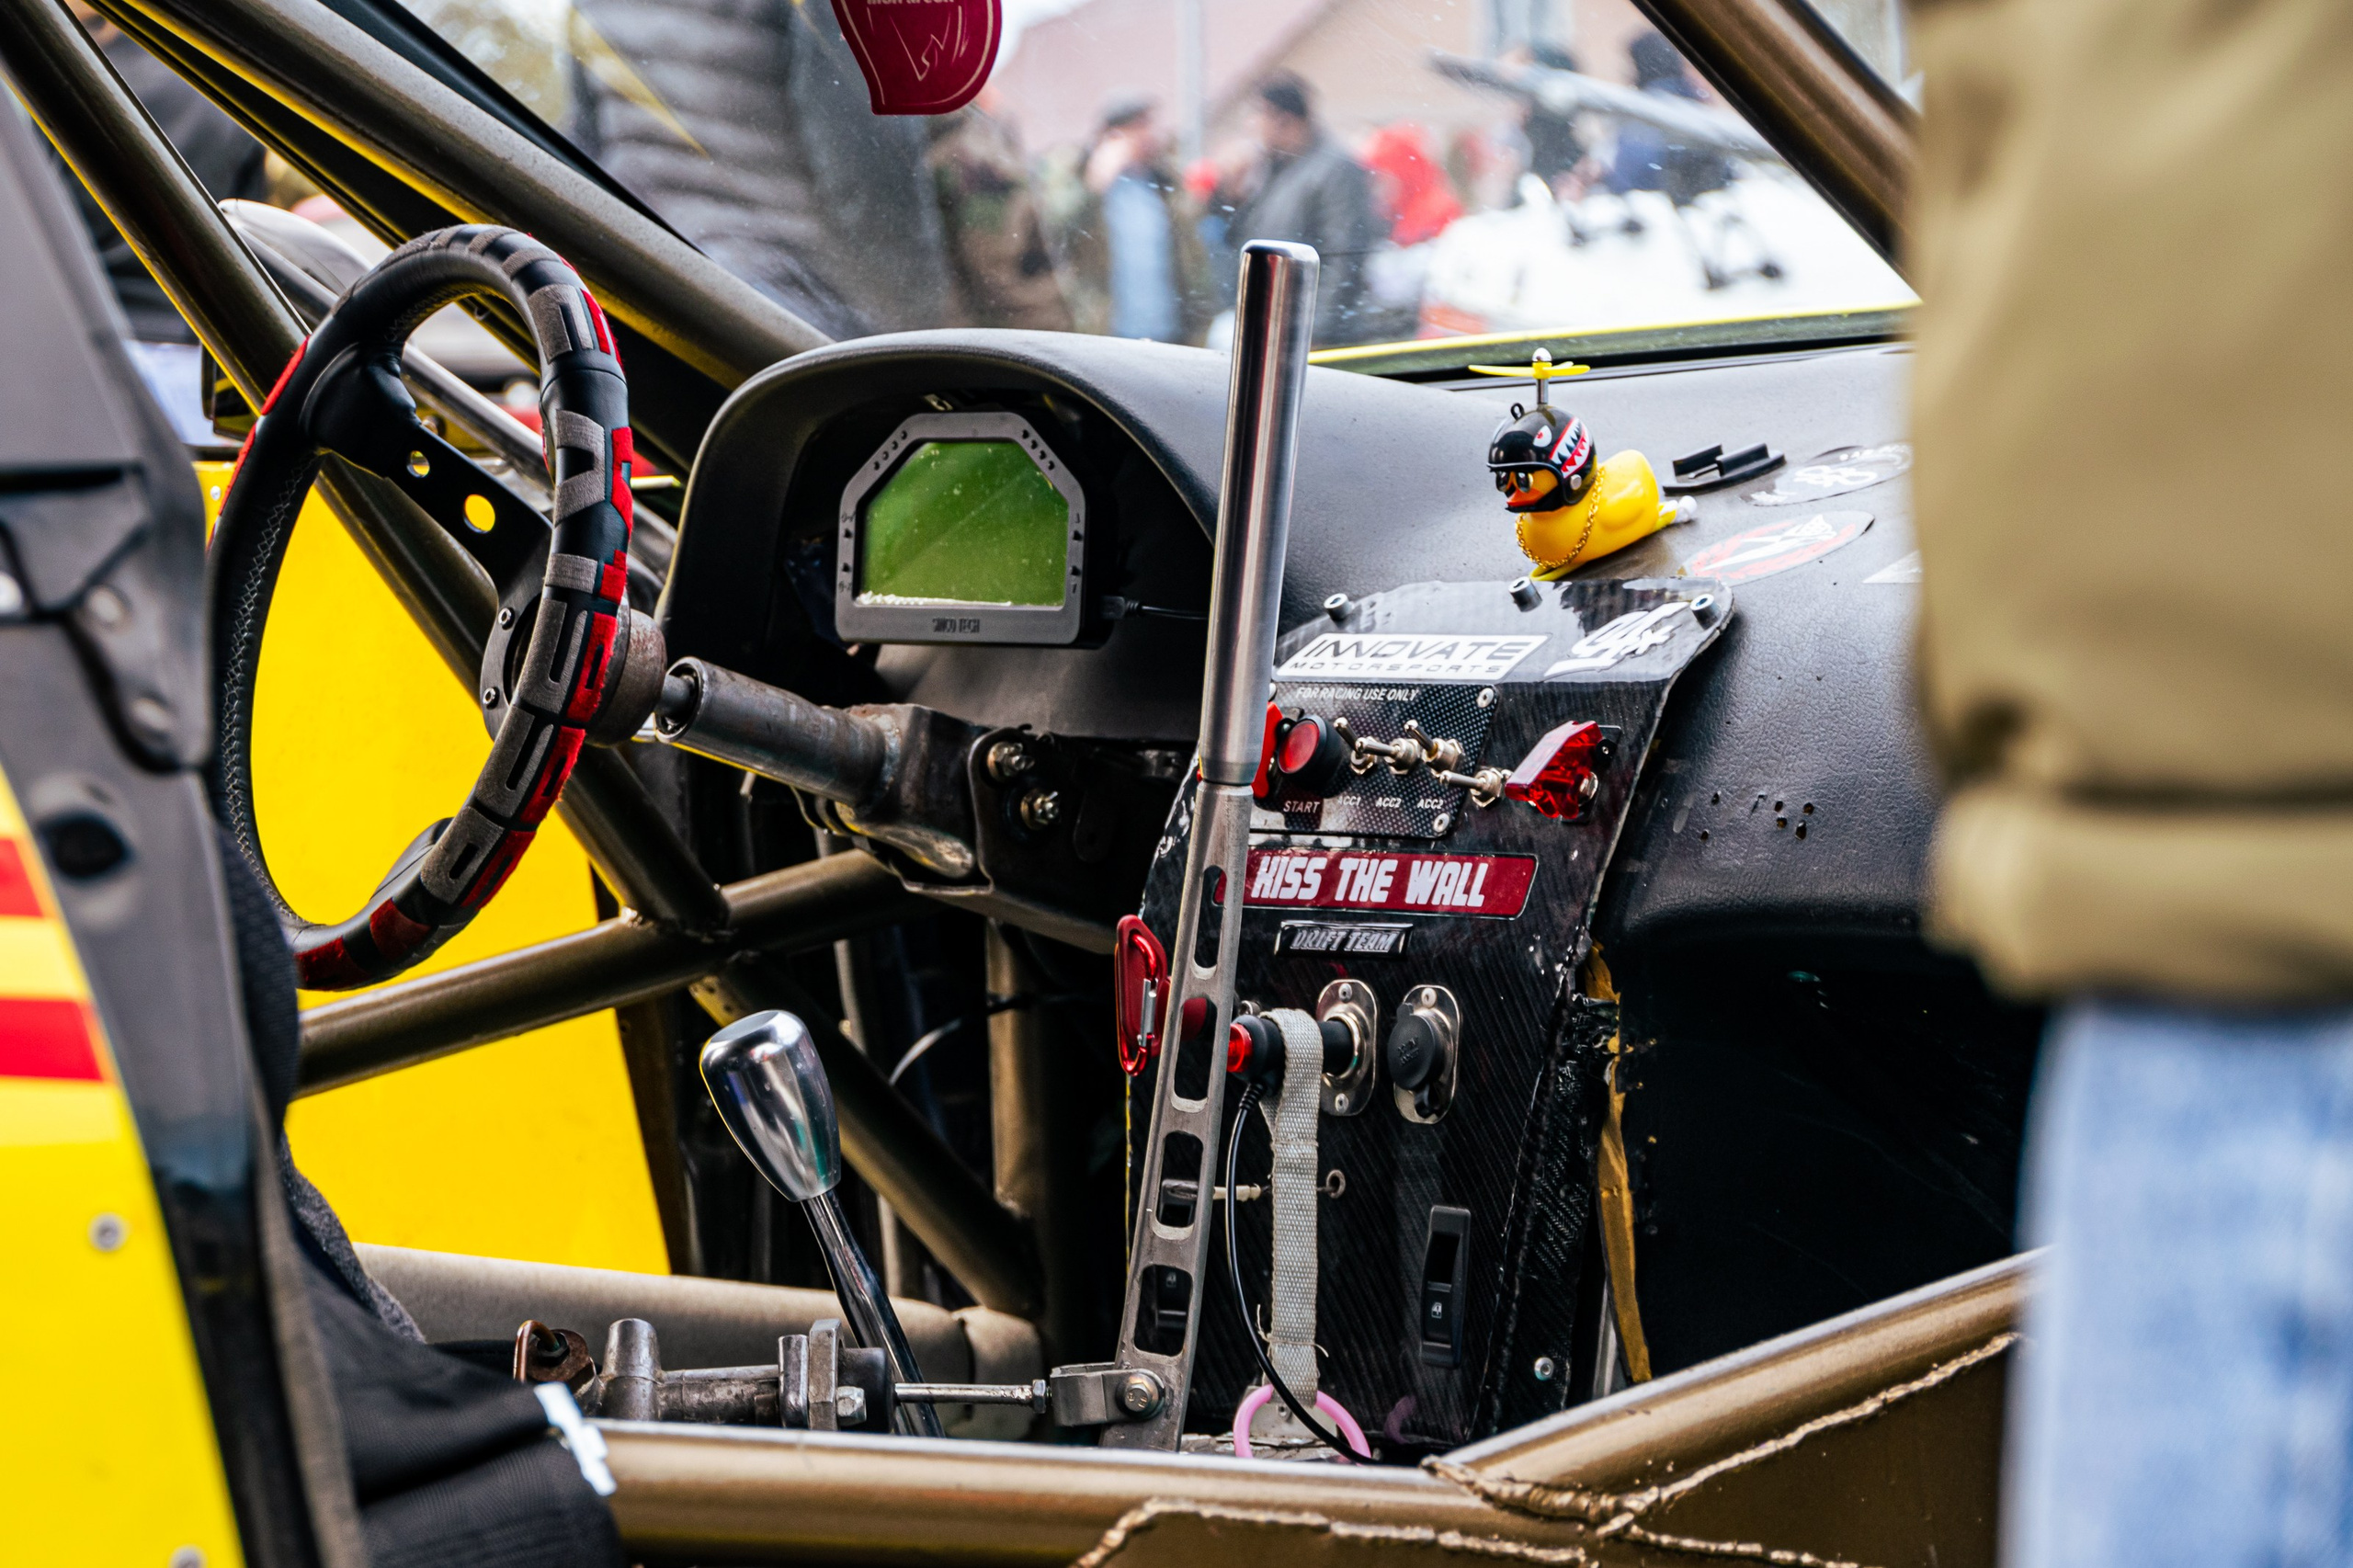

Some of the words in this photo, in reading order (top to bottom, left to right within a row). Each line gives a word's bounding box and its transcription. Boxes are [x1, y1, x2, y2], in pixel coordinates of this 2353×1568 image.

[1303, 640, 1531, 661] INNOVATE
[1289, 662, 1504, 674] MOTORSPORTS
[1295, 687, 1320, 699] FOR
[1319, 687, 1363, 700] RACING
[1363, 687, 1387, 701] USE
[1386, 688, 1419, 702] ONLY
[1283, 801, 1321, 813] START
[1251, 856, 1328, 900] KISS
[1335, 858, 1398, 903] THE
[1404, 860, 1489, 907] WALL
[1290, 927, 1348, 951] DRIFT
[1344, 929, 1401, 953] TEAM
